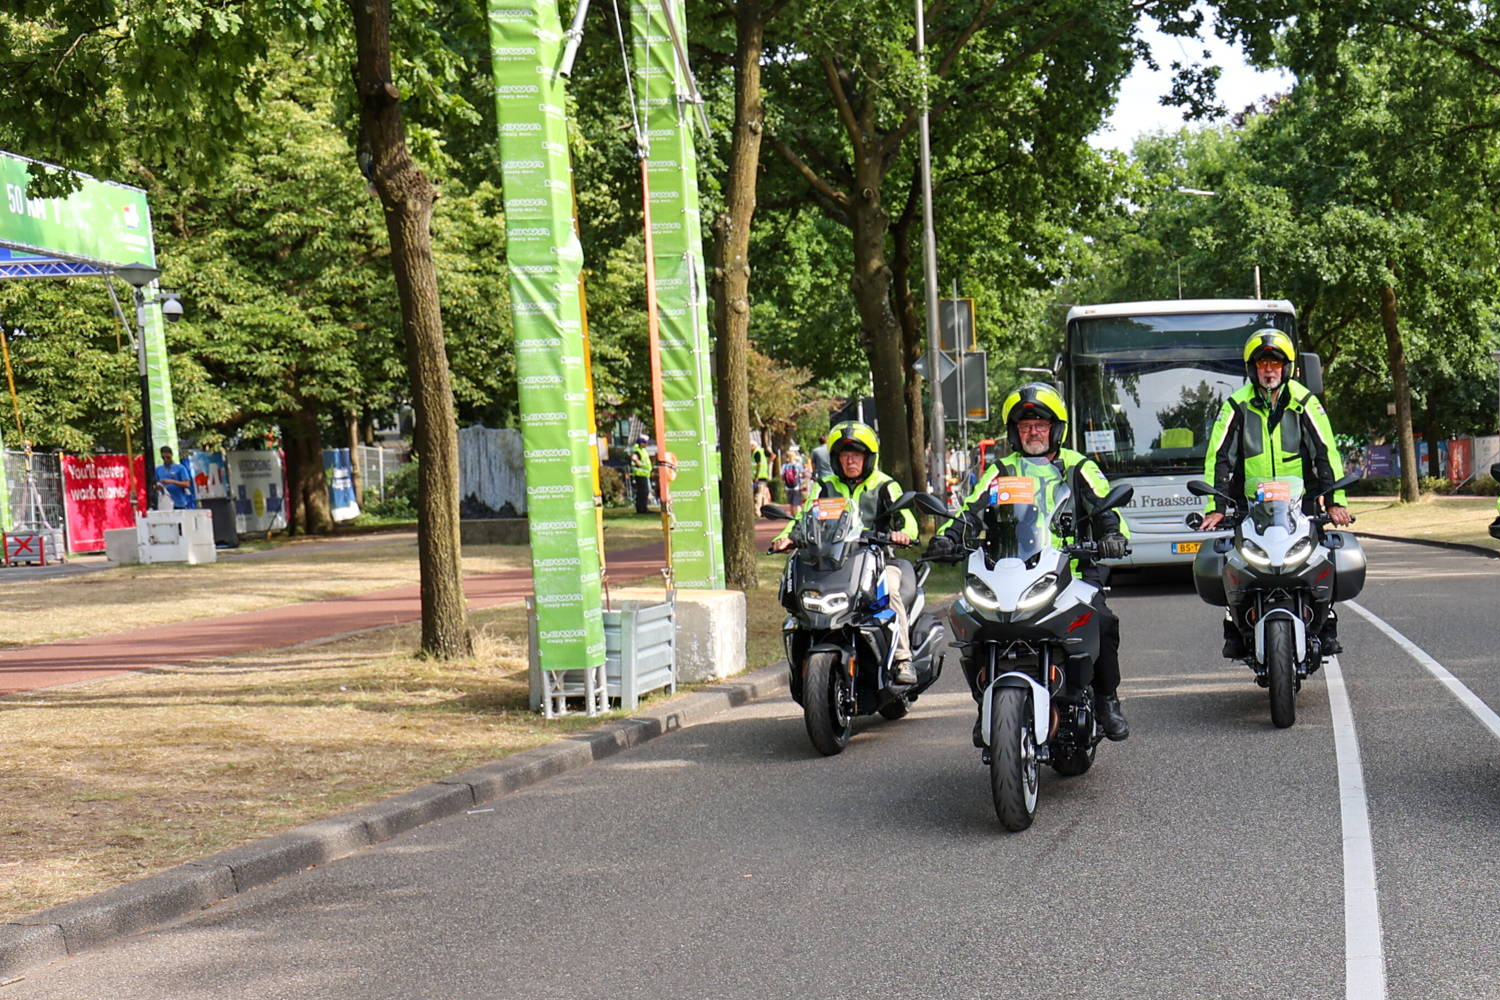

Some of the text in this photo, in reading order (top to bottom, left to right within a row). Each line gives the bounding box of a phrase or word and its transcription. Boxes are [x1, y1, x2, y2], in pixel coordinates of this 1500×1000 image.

[7, 184, 24, 215] 50
[68, 463, 125, 480] You'll never
[70, 486, 127, 502] work alone
[1141, 494, 1202, 508] Fraassen
